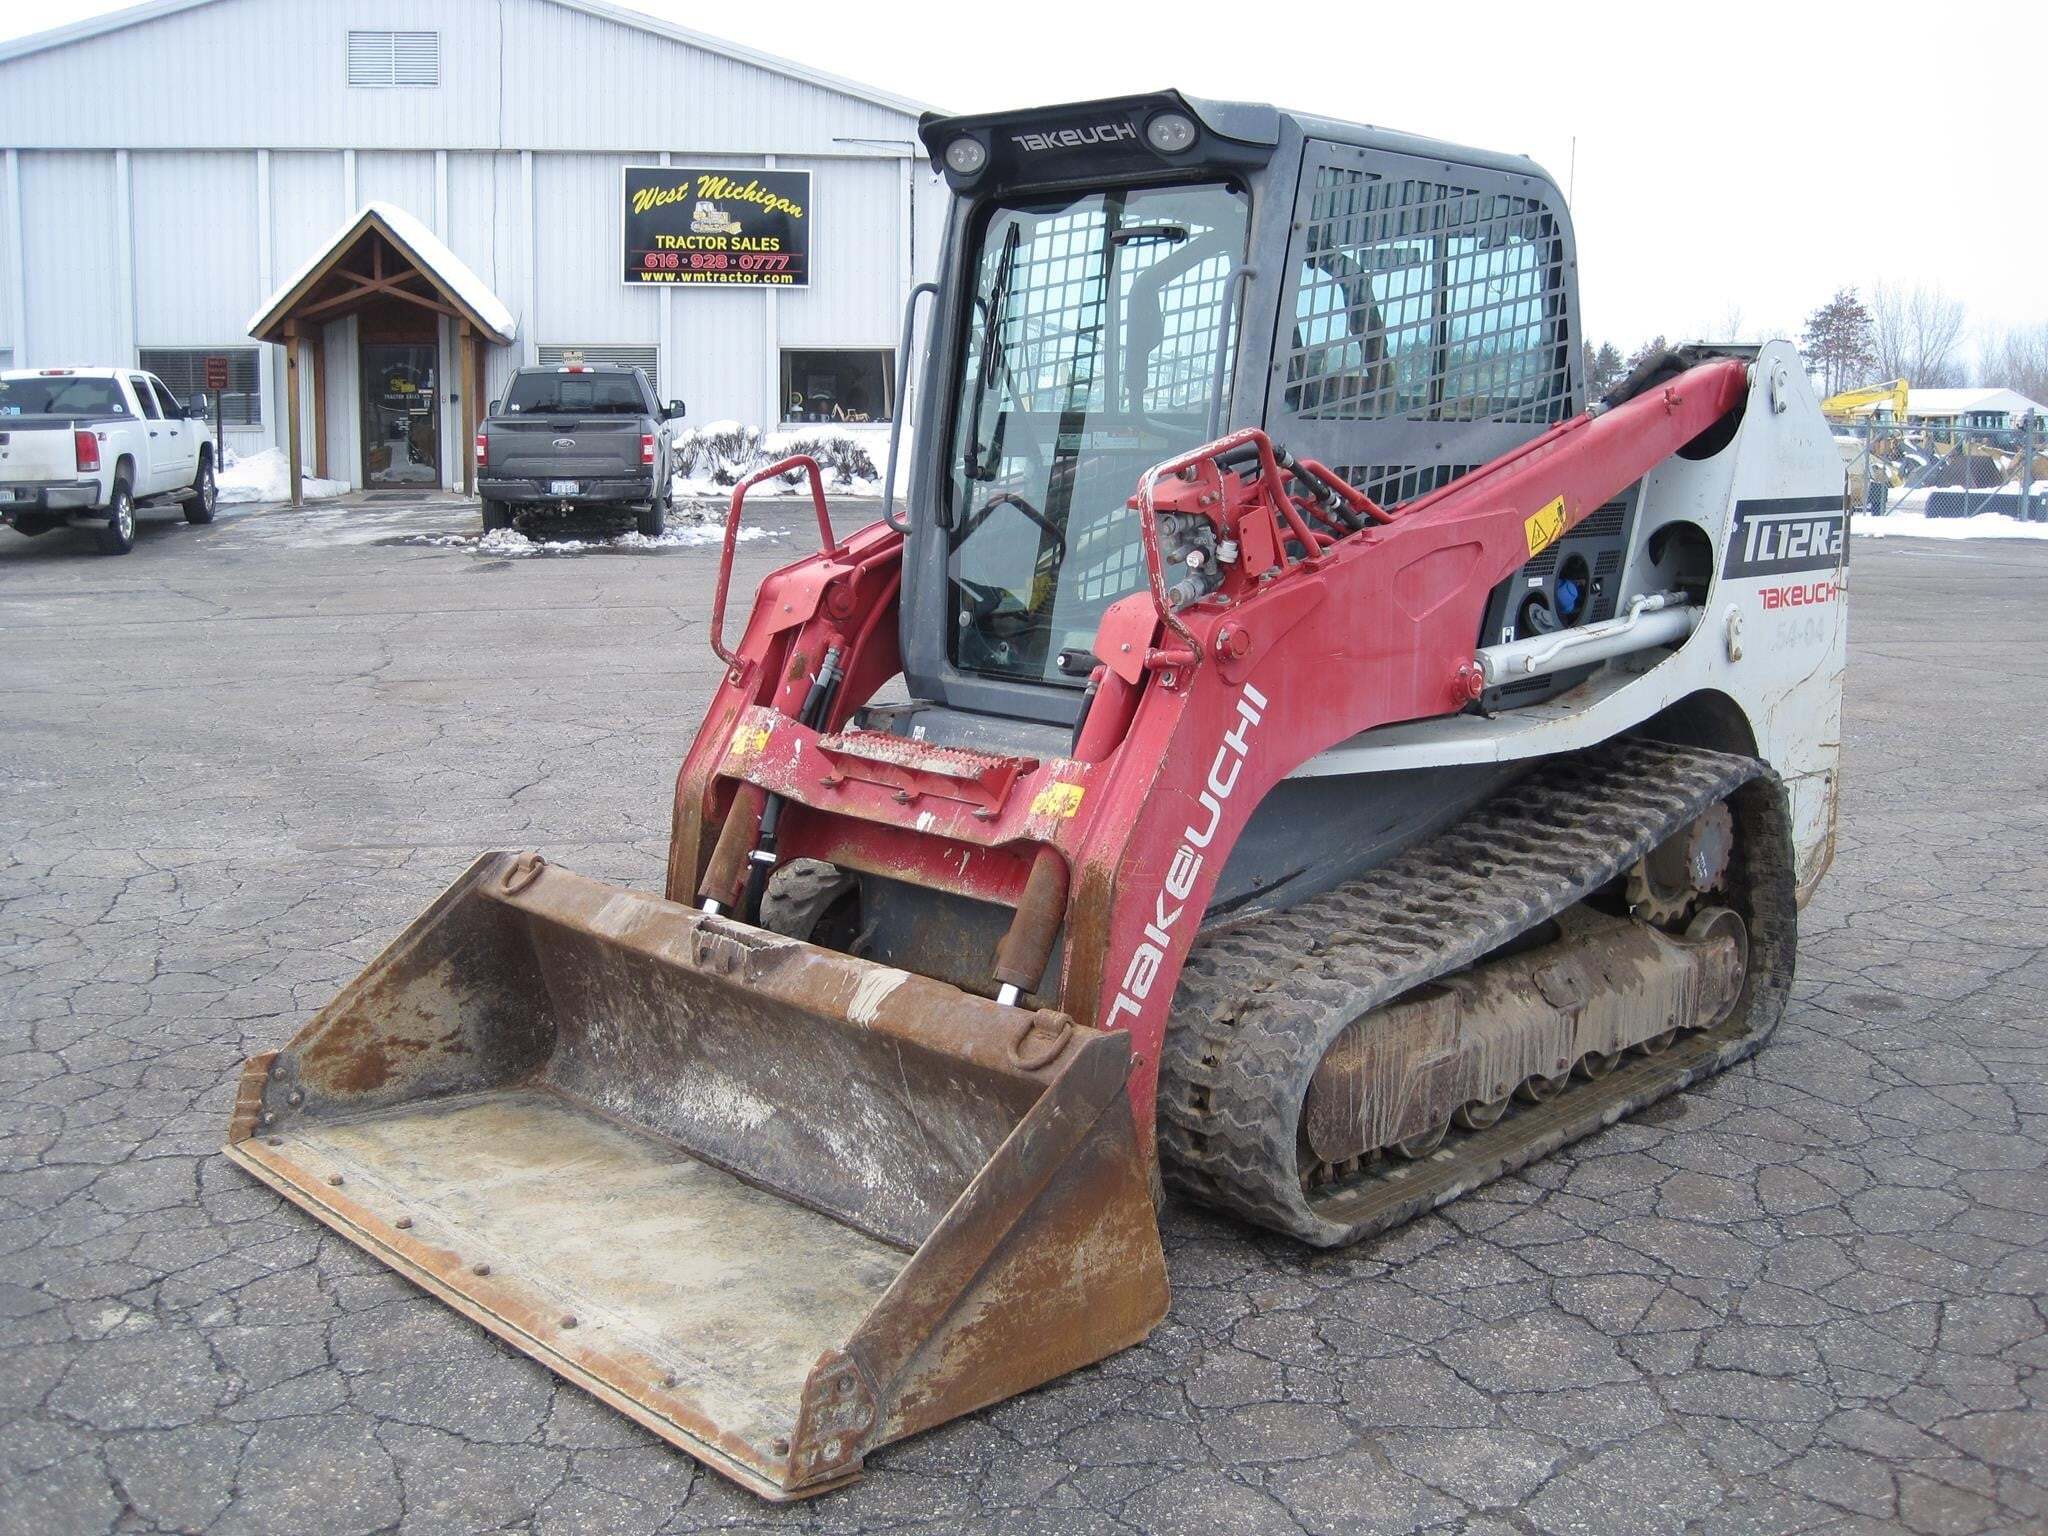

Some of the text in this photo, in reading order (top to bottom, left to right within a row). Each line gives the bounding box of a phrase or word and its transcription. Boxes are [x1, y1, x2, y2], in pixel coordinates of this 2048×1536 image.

[633, 175, 803, 218] West Michigan
[655, 235, 780, 251] TRACTOR SALES
[641, 271, 793, 283] www.wmtractor.com
[1758, 582, 1837, 609] TAKEUCH
[1106, 682, 1268, 1027] TAKEUCHI
